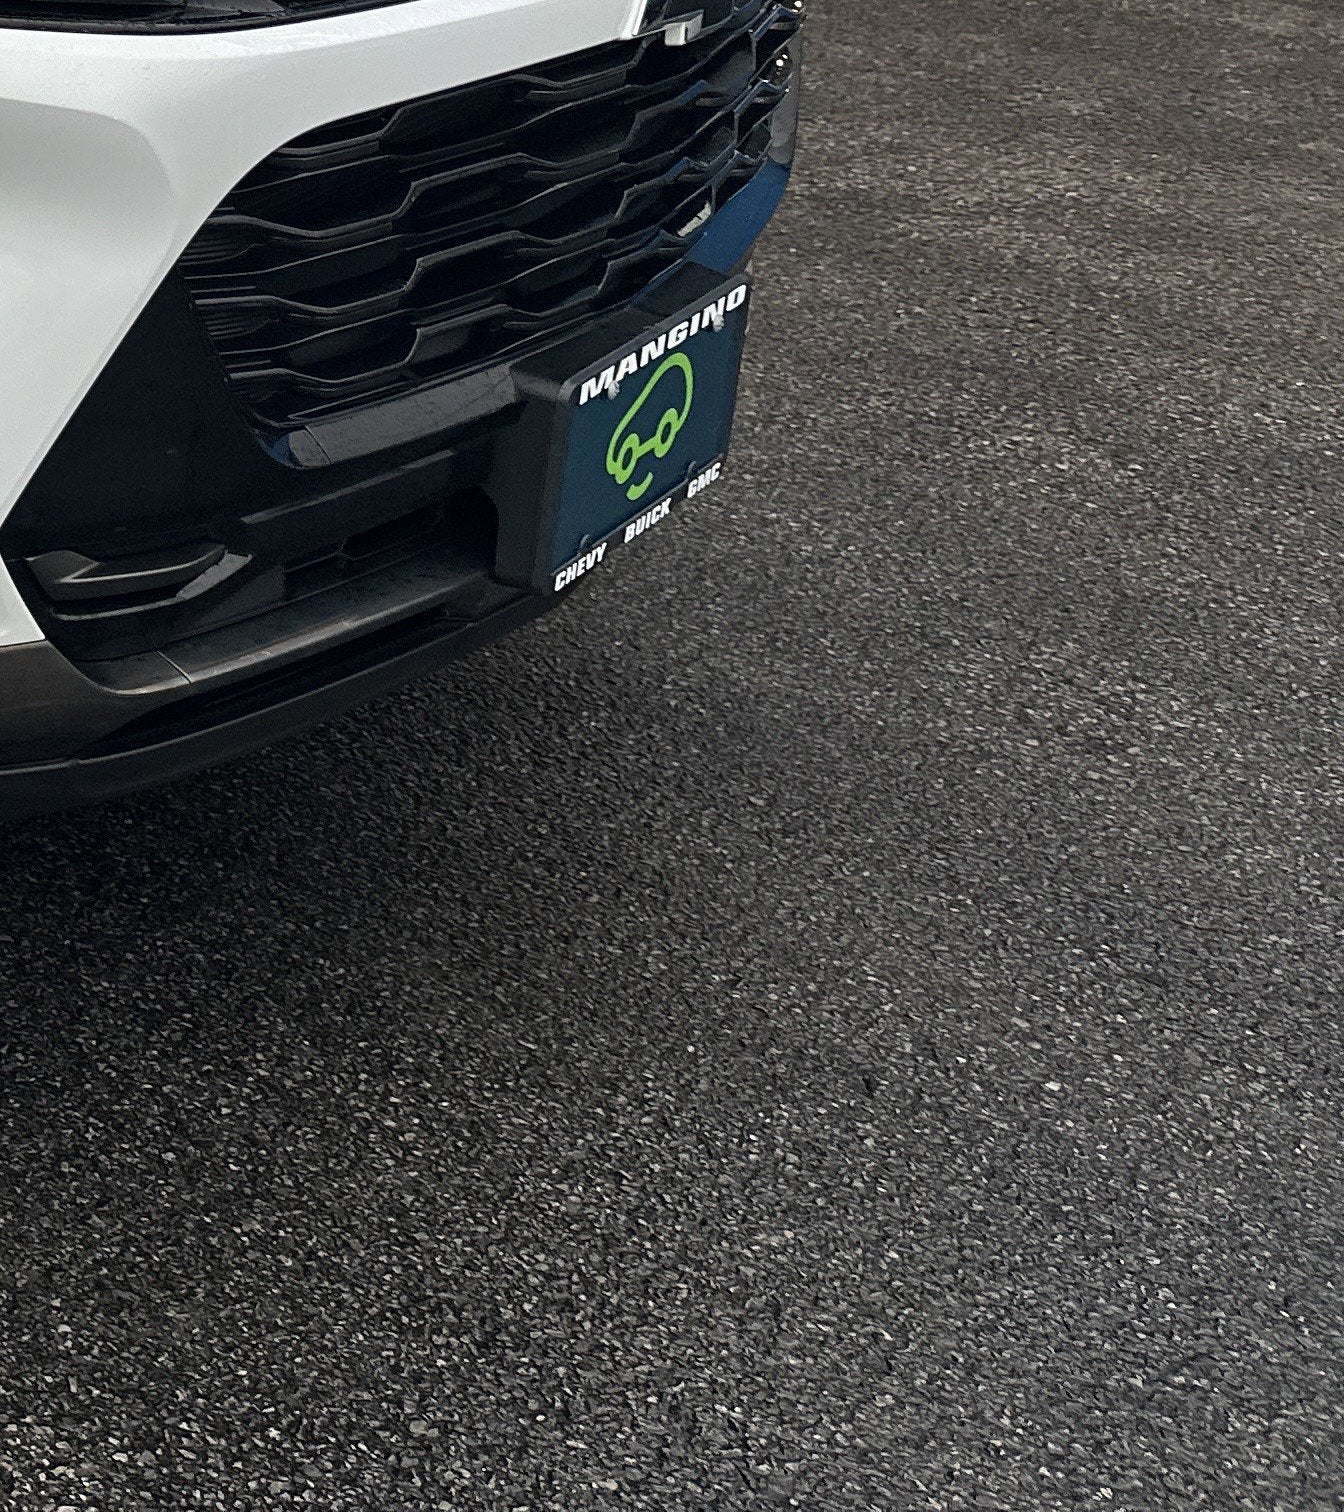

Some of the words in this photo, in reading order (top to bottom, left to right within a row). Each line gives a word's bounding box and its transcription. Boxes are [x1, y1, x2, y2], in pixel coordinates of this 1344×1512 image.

[579, 284, 747, 405] MANGINO
[554, 542, 607, 591] CHEVY
[624, 497, 671, 543] BUICK
[687, 462, 721, 498] GMC
